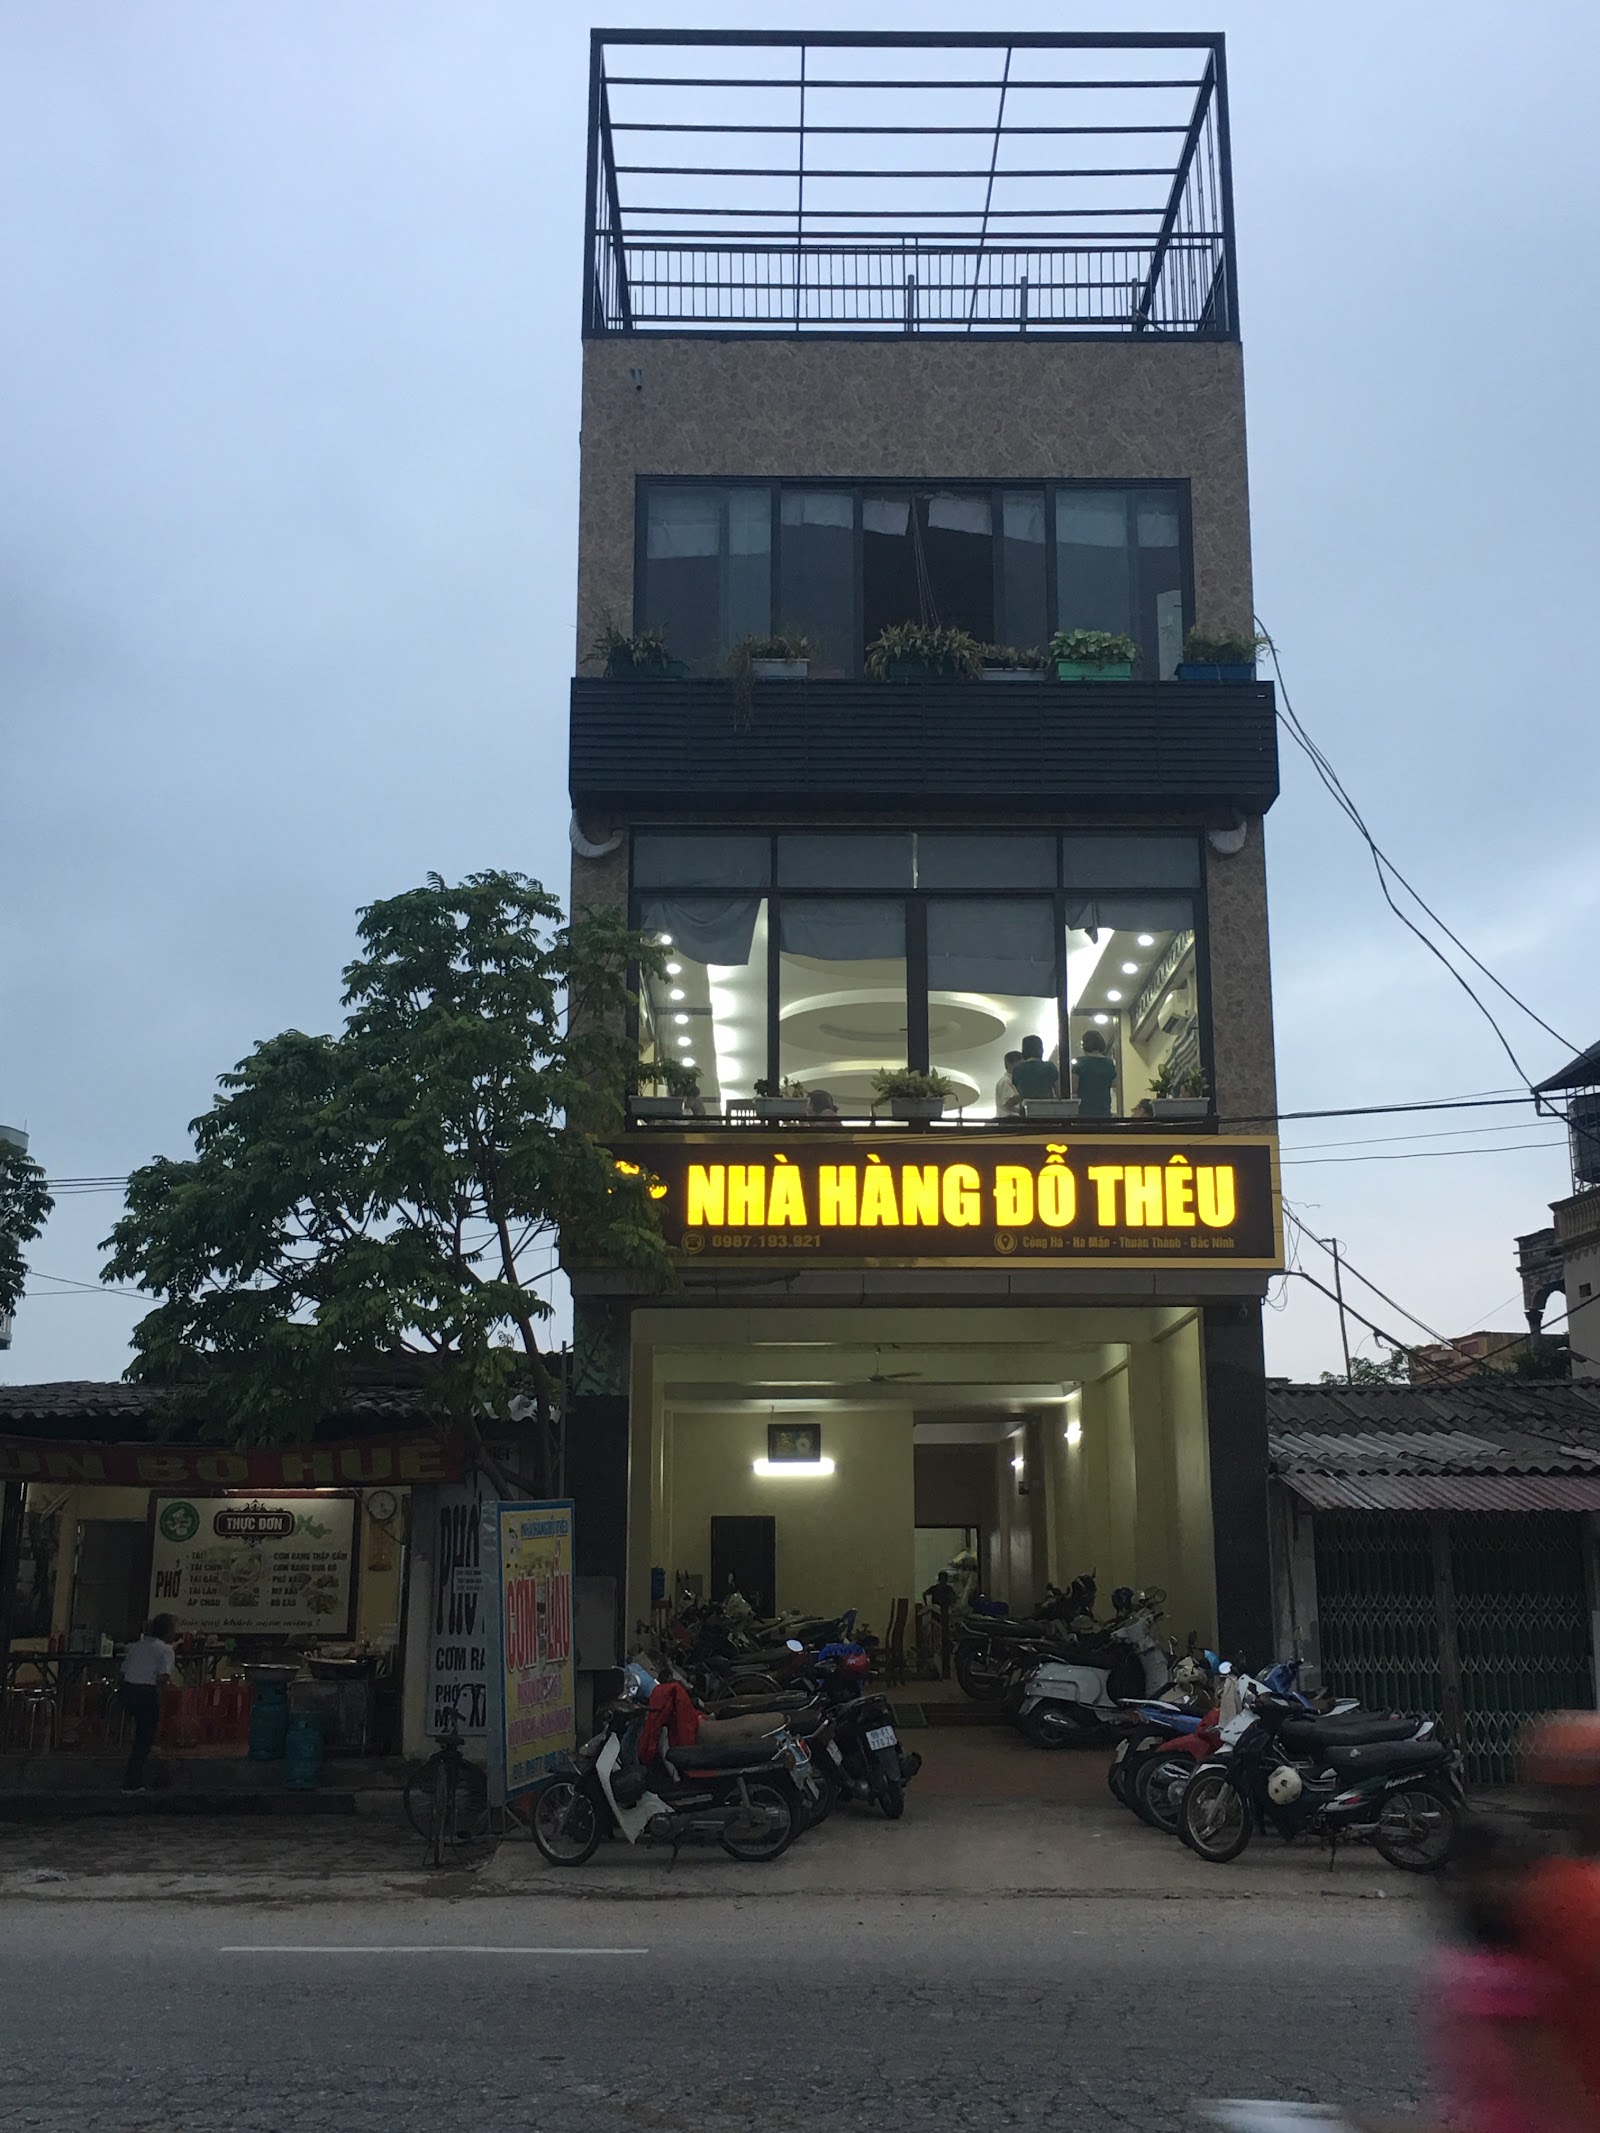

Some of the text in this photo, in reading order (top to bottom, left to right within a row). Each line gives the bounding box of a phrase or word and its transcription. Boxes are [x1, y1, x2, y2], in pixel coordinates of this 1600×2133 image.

[687, 1142, 1237, 1228] NHÀ HÀNG ĐỖ THÊU
[226, 1516, 284, 1533] THỰC ĐƠN
[155, 1558, 183, 1598] PHỞ
[435, 1645, 467, 1672] CƠM
